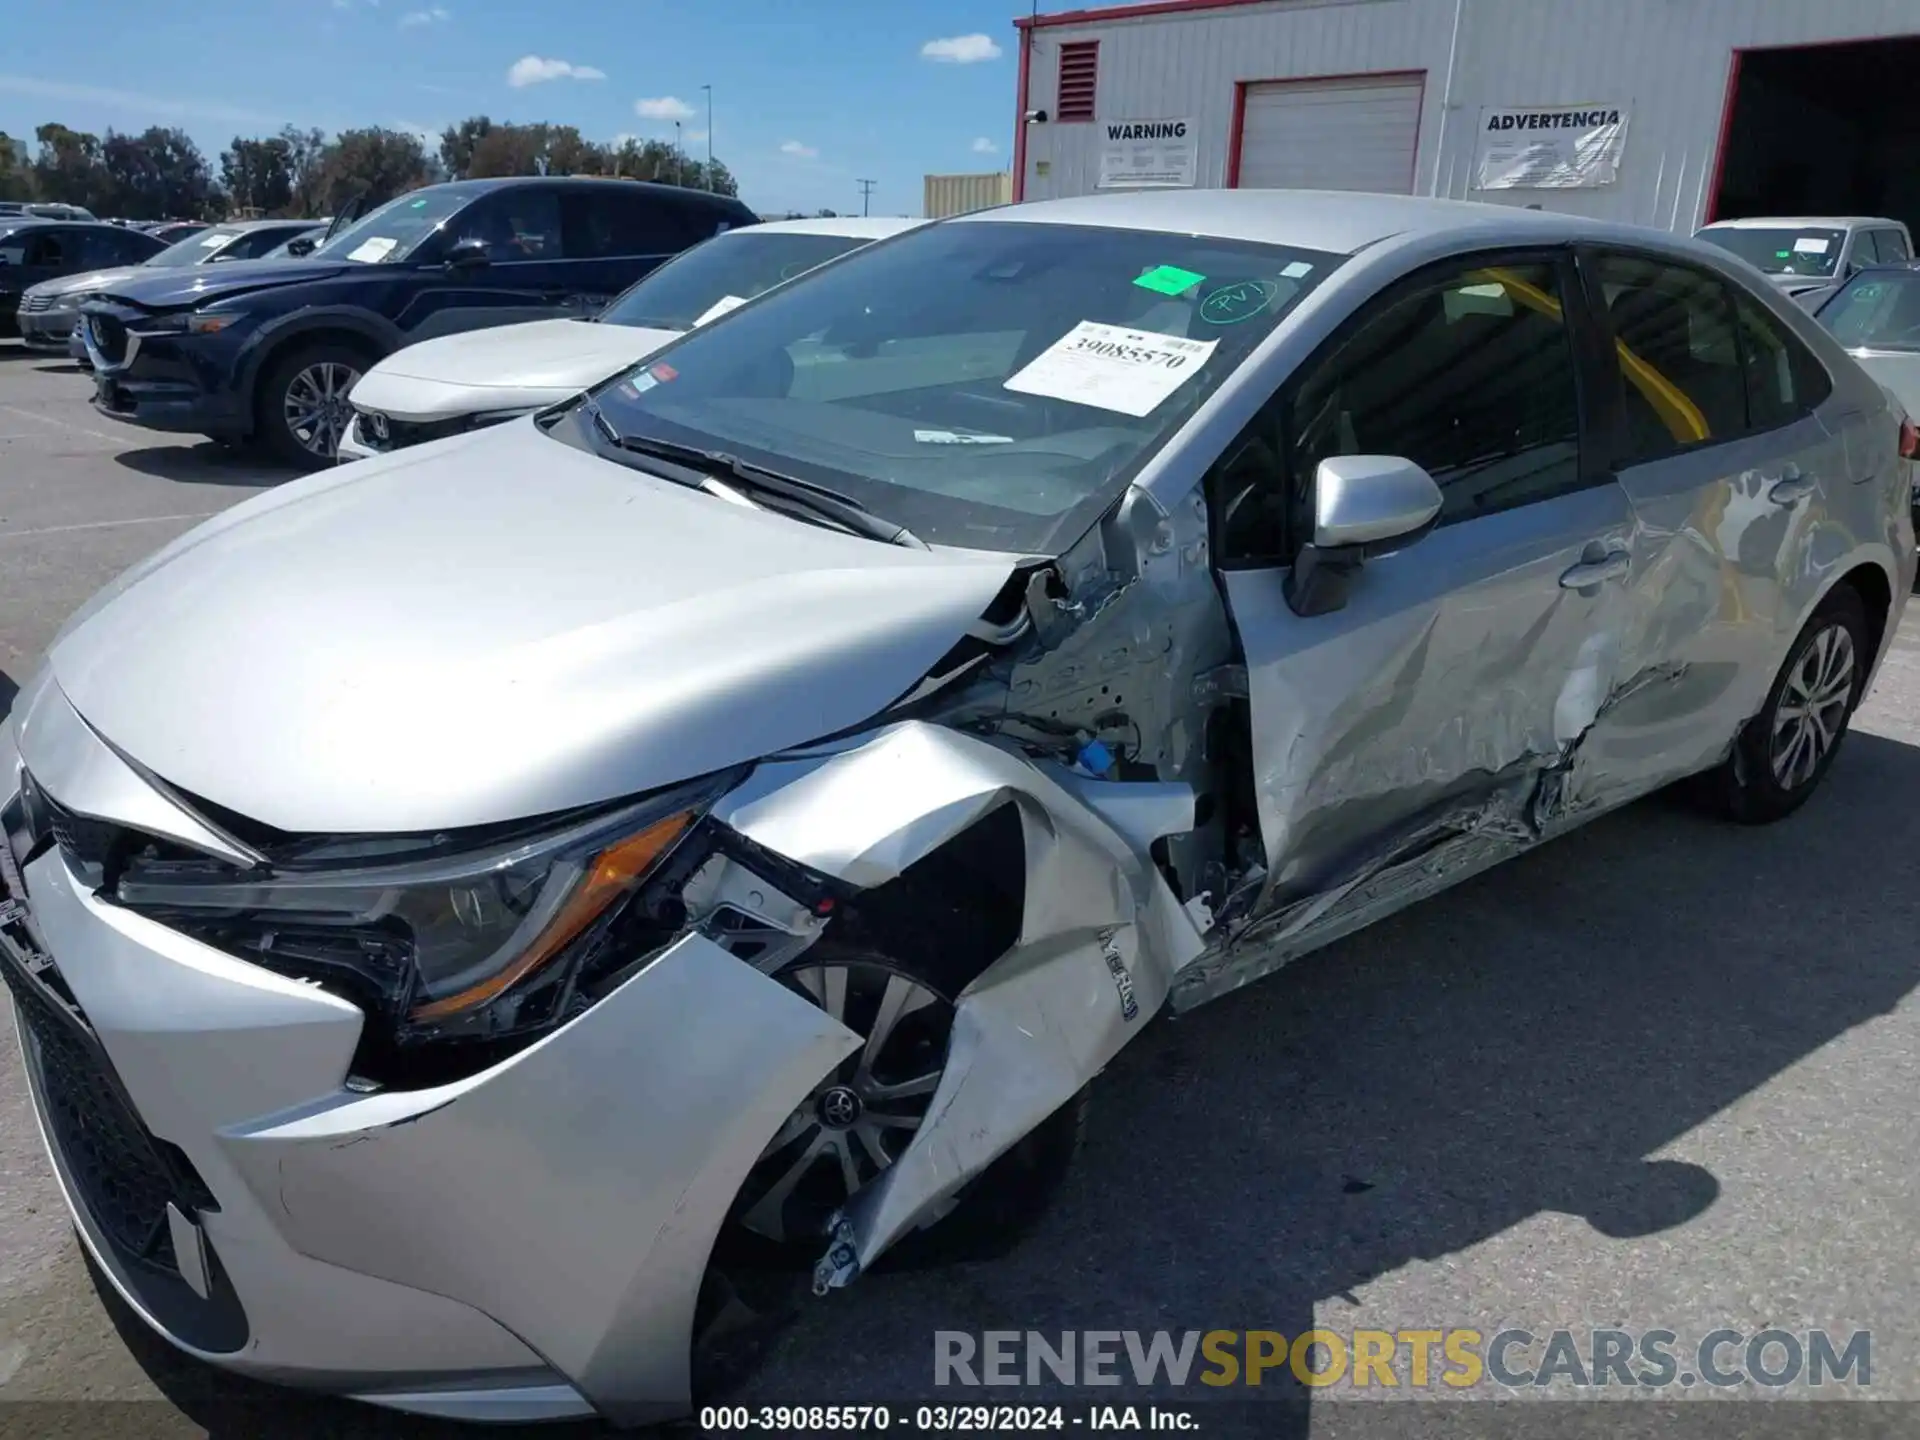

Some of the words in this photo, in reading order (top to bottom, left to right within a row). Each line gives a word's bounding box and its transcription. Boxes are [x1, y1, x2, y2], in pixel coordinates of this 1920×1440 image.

[1487, 110, 1619, 131] ADVERTENCIA
[1107, 122, 1187, 141] WARNING
[1066, 337, 1187, 369] 39085570
